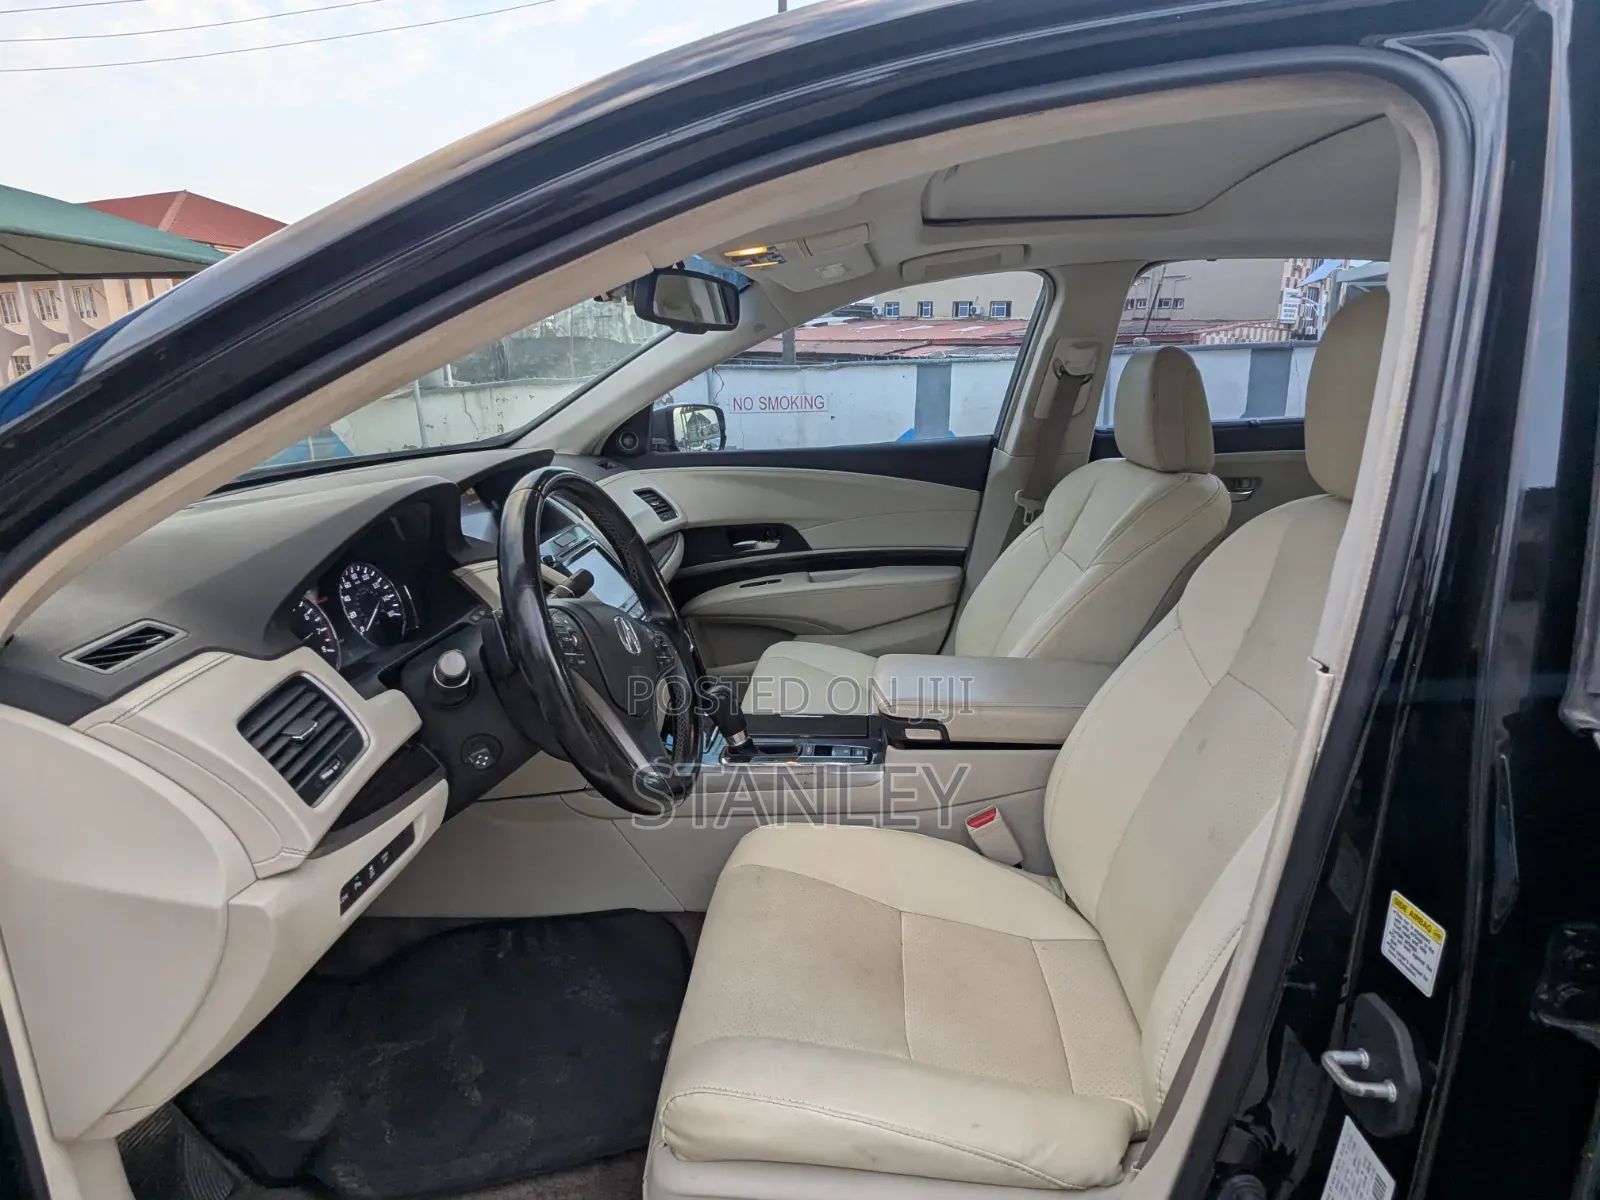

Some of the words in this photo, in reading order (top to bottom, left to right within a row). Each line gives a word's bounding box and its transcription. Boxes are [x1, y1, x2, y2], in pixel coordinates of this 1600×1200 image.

[733, 396, 754, 411] NO
[758, 395, 825, 411] SMOKING
[1394, 897, 1407, 913] SIDE
[1408, 910, 1432, 933] AIRBAG
